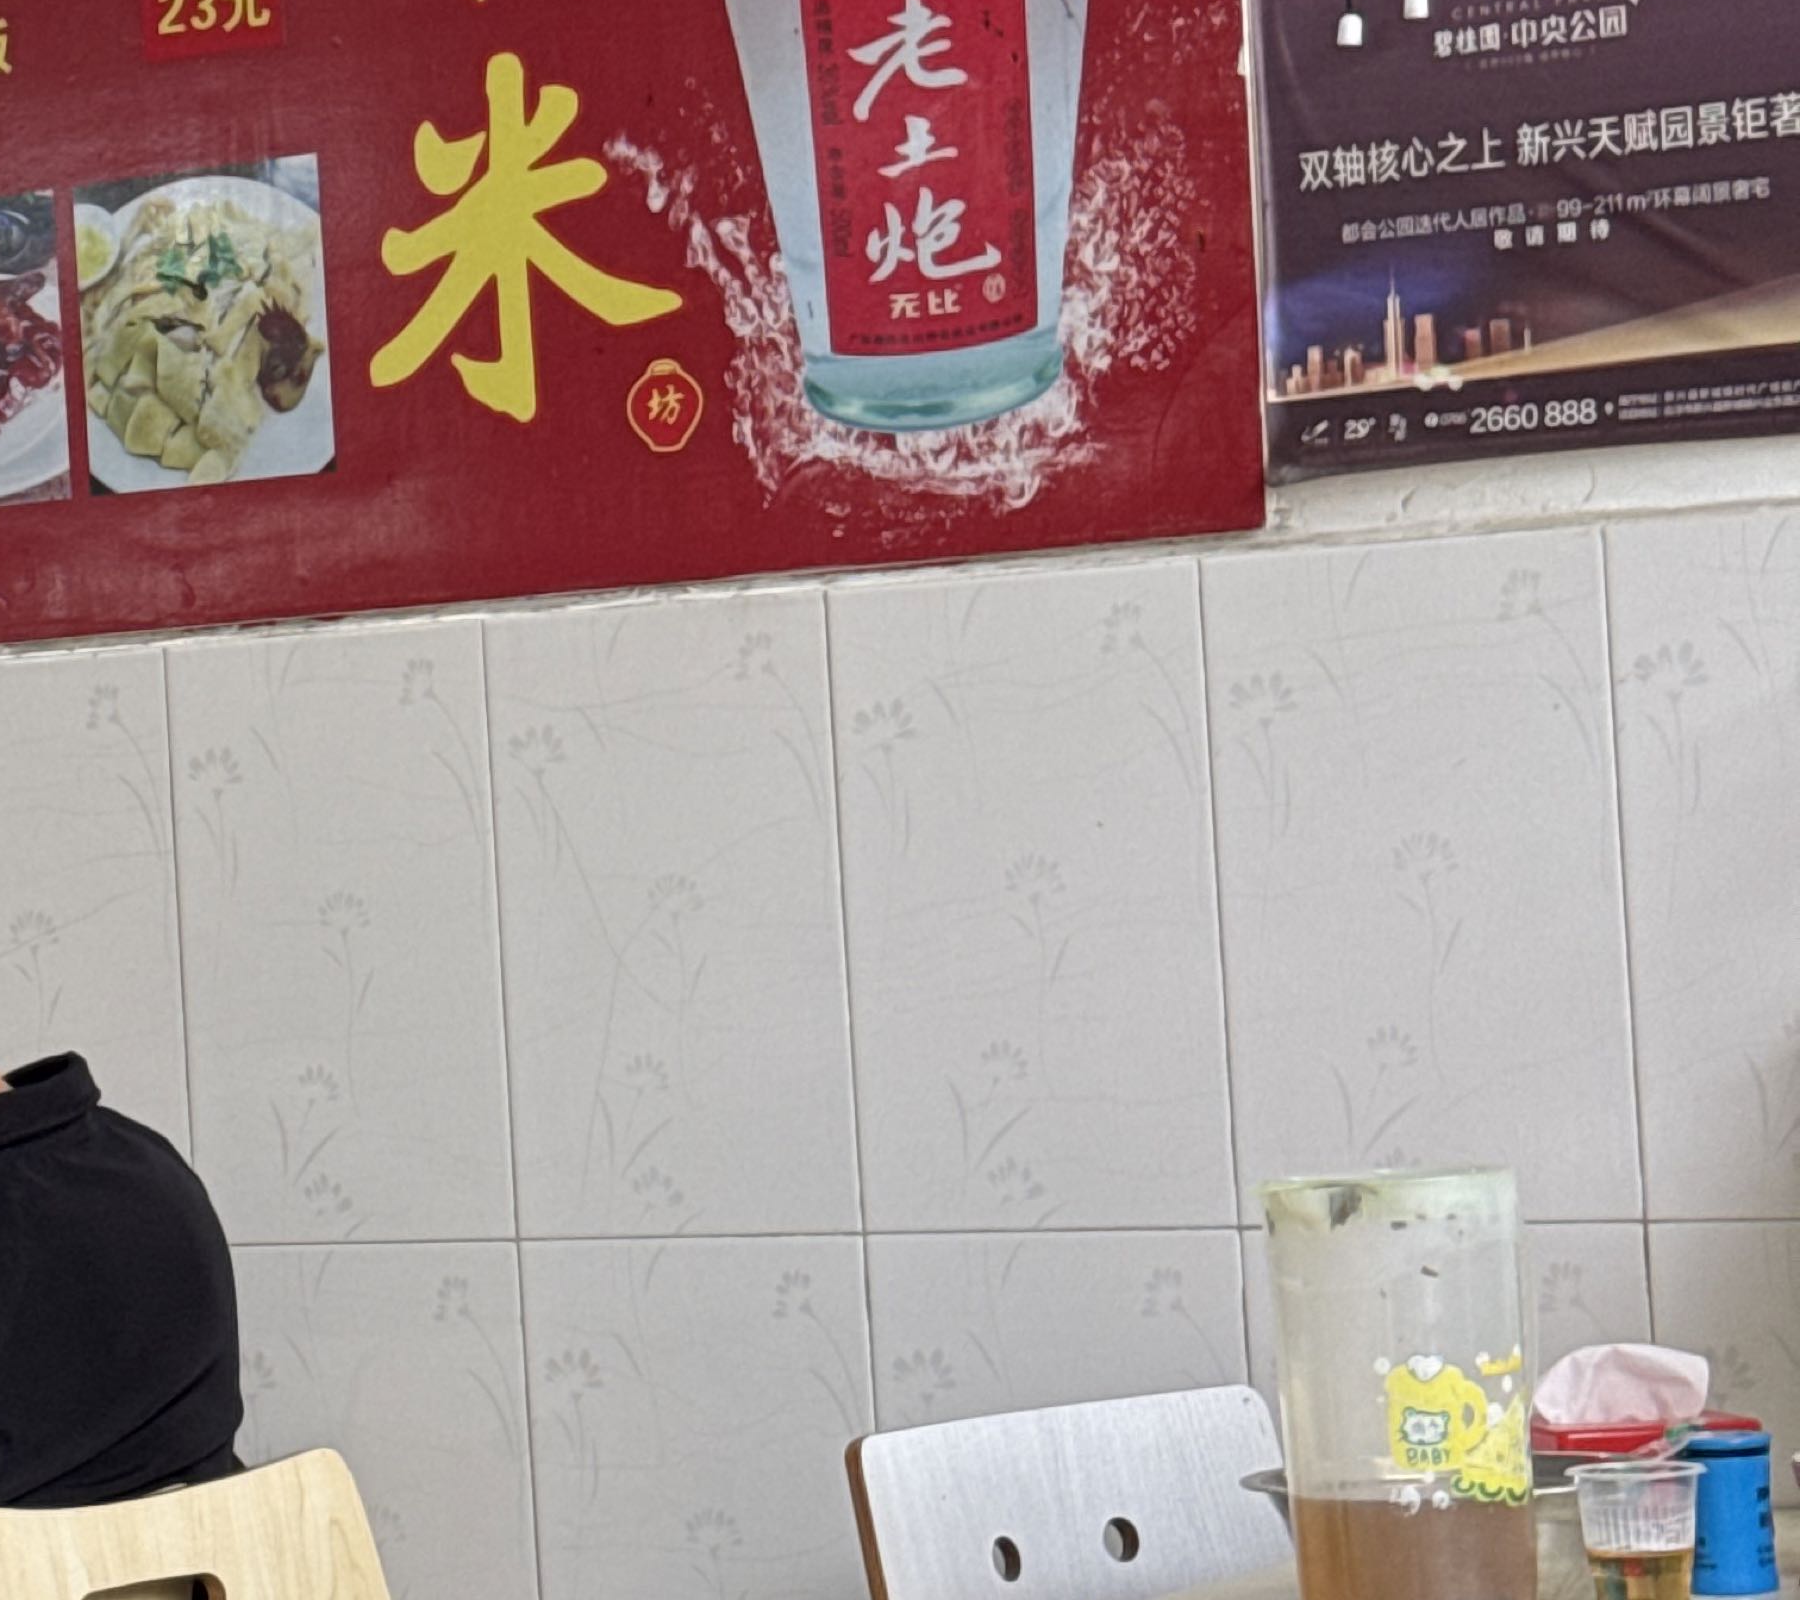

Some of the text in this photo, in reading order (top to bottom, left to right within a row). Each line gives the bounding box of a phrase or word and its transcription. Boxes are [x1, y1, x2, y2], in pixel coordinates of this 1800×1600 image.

[1298, 126, 1506, 192] 双轴核心之上
[646, 383, 686, 425] 坊
[1469, 403, 1539, 435] 2660
[1543, 397, 1598, 428] 888
